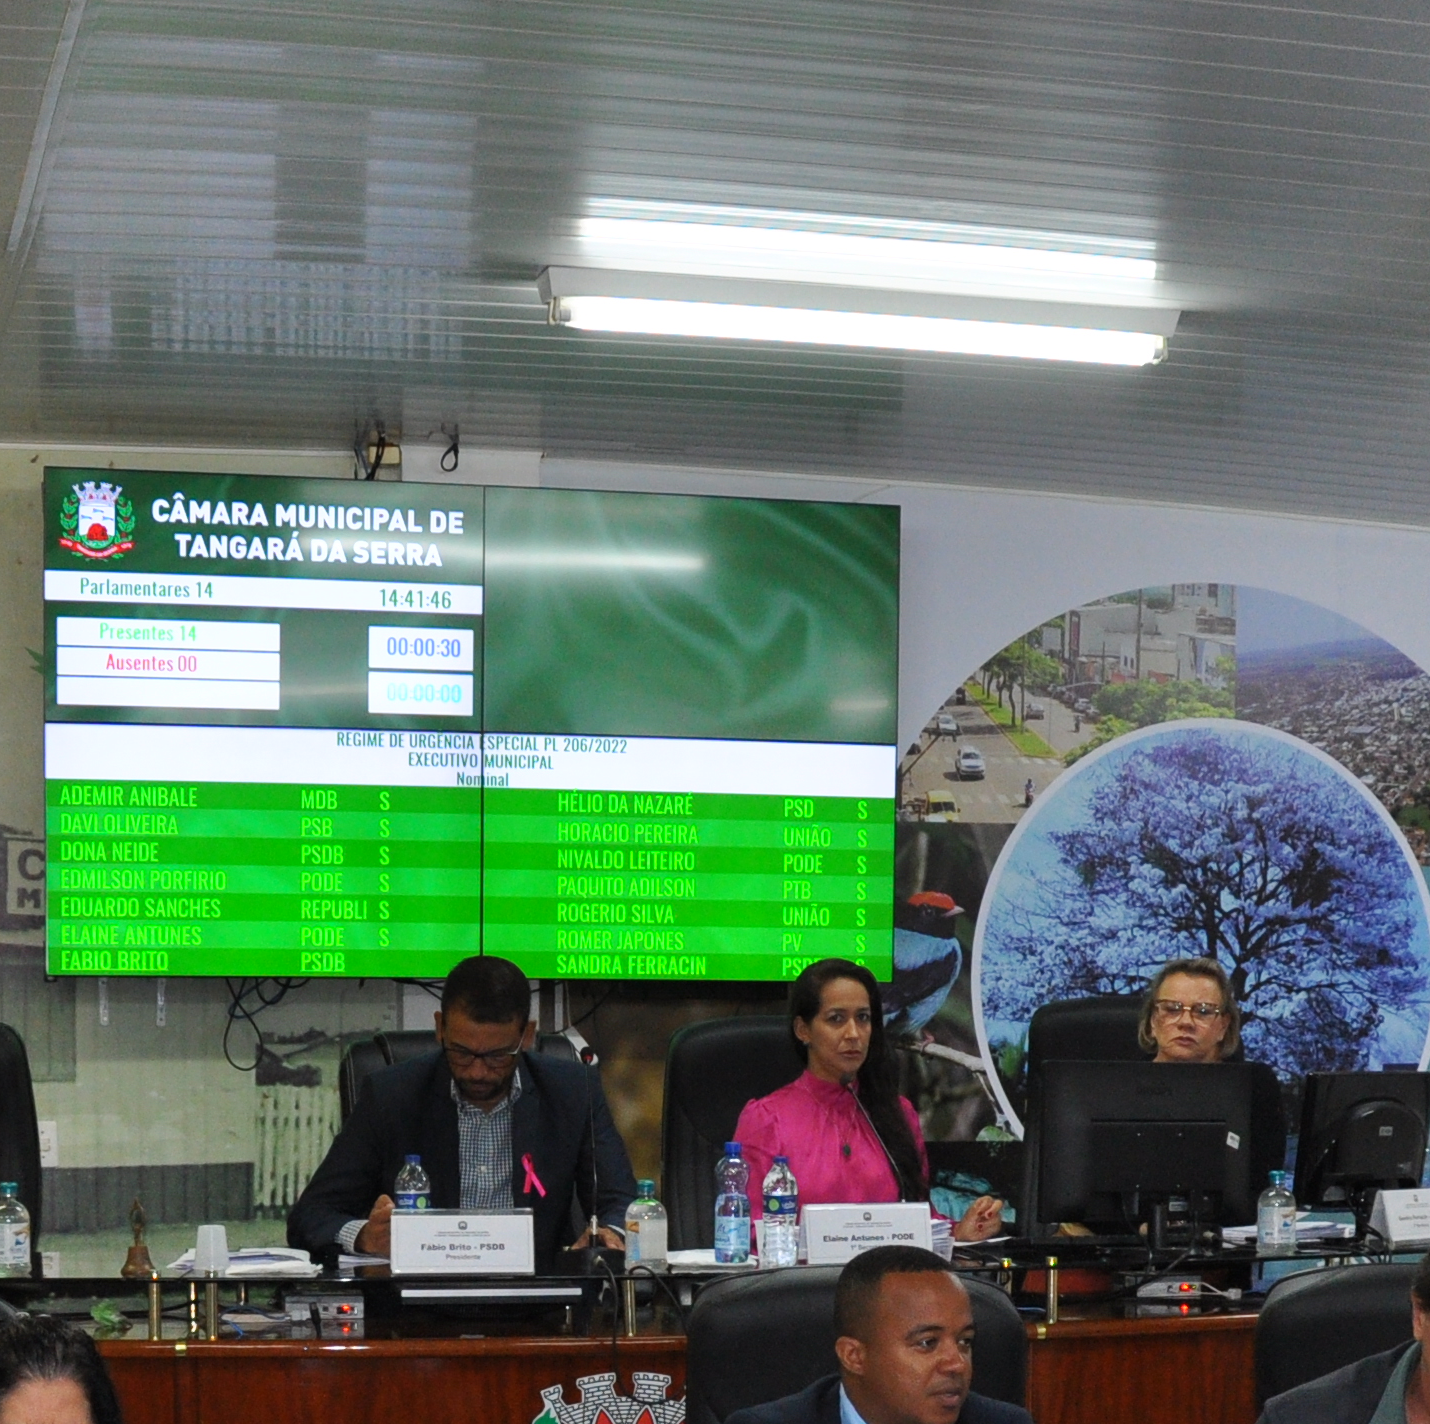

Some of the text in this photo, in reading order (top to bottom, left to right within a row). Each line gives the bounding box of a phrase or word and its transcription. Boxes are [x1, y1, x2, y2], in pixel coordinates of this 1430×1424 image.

[152, 492, 464, 534] CÂMARA MUNICIPAL DE
[175, 532, 442, 566] TANGARÁ DA SERRA
[80, 578, 213, 598] Parlamentares 14
[379, 588, 452, 609] 14:41:46
[99, 623, 197, 642] Presentes 14
[387, 637, 461, 658] 00:00:30
[106, 654, 197, 672] Ausentes 00
[387, 682, 461, 703] 00:00:00
[336, 731, 627, 754] REGIME DE URGÊNCIA ESPECIAL PL 206/2022
[408, 752, 554, 770] EXECUTIVO MUNICIPAL
[60, 786, 197, 807] ADEMIR ANIBALE
[300, 790, 338, 809] MDB
[379, 792, 390, 810] S
[558, 790, 693, 816] HÉLIO DA NAZARÉ
[784, 799, 813, 818] PSD
[857, 800, 868, 820] S
[60, 814, 178, 834] DAVI OLIVEIRA
[300, 817, 333, 837] PSB
[379, 819, 390, 837] S
[558, 822, 699, 845] HORACIO PEREIRA
[783, 825, 832, 847] UNIÃO
[857, 828, 868, 848] S
[61, 842, 158, 862] DONA NEIDE
[300, 845, 344, 864] PSDB
[379, 846, 390, 865] S
[557, 850, 695, 871] NIVALDO LEITEIRO
[783, 854, 823, 873] PODE
[857, 855, 867, 875] S
[61, 870, 226, 890] EDMILSON PORFIRIO
[300, 873, 343, 892] PODE
[379, 874, 390, 892] S
[557, 877, 695, 898] PAQUITO ADILSON
[783, 880, 811, 899] PTB
[856, 882, 867, 901] S
[61, 898, 221, 918] EDUARDO SANCHES
[300, 901, 367, 920] REPUBLI
[379, 901, 390, 920] S
[557, 904, 674, 924] ROGERIO SILVA
[782, 905, 830, 927] UNIÃO
[856, 908, 866, 927] S
[61, 925, 202, 946] ELAINE ANTUNES
[300, 927, 344, 946] PODE
[379, 928, 390, 946] S
[557, 930, 684, 951] ROMER JAPONES
[782, 933, 803, 952] PV
[856, 934, 865, 953] S
[61, 950, 168, 970] FABIO BRITO
[300, 952, 345, 972] PSDB
[557, 955, 706, 975] SANDRA FERRACIN
